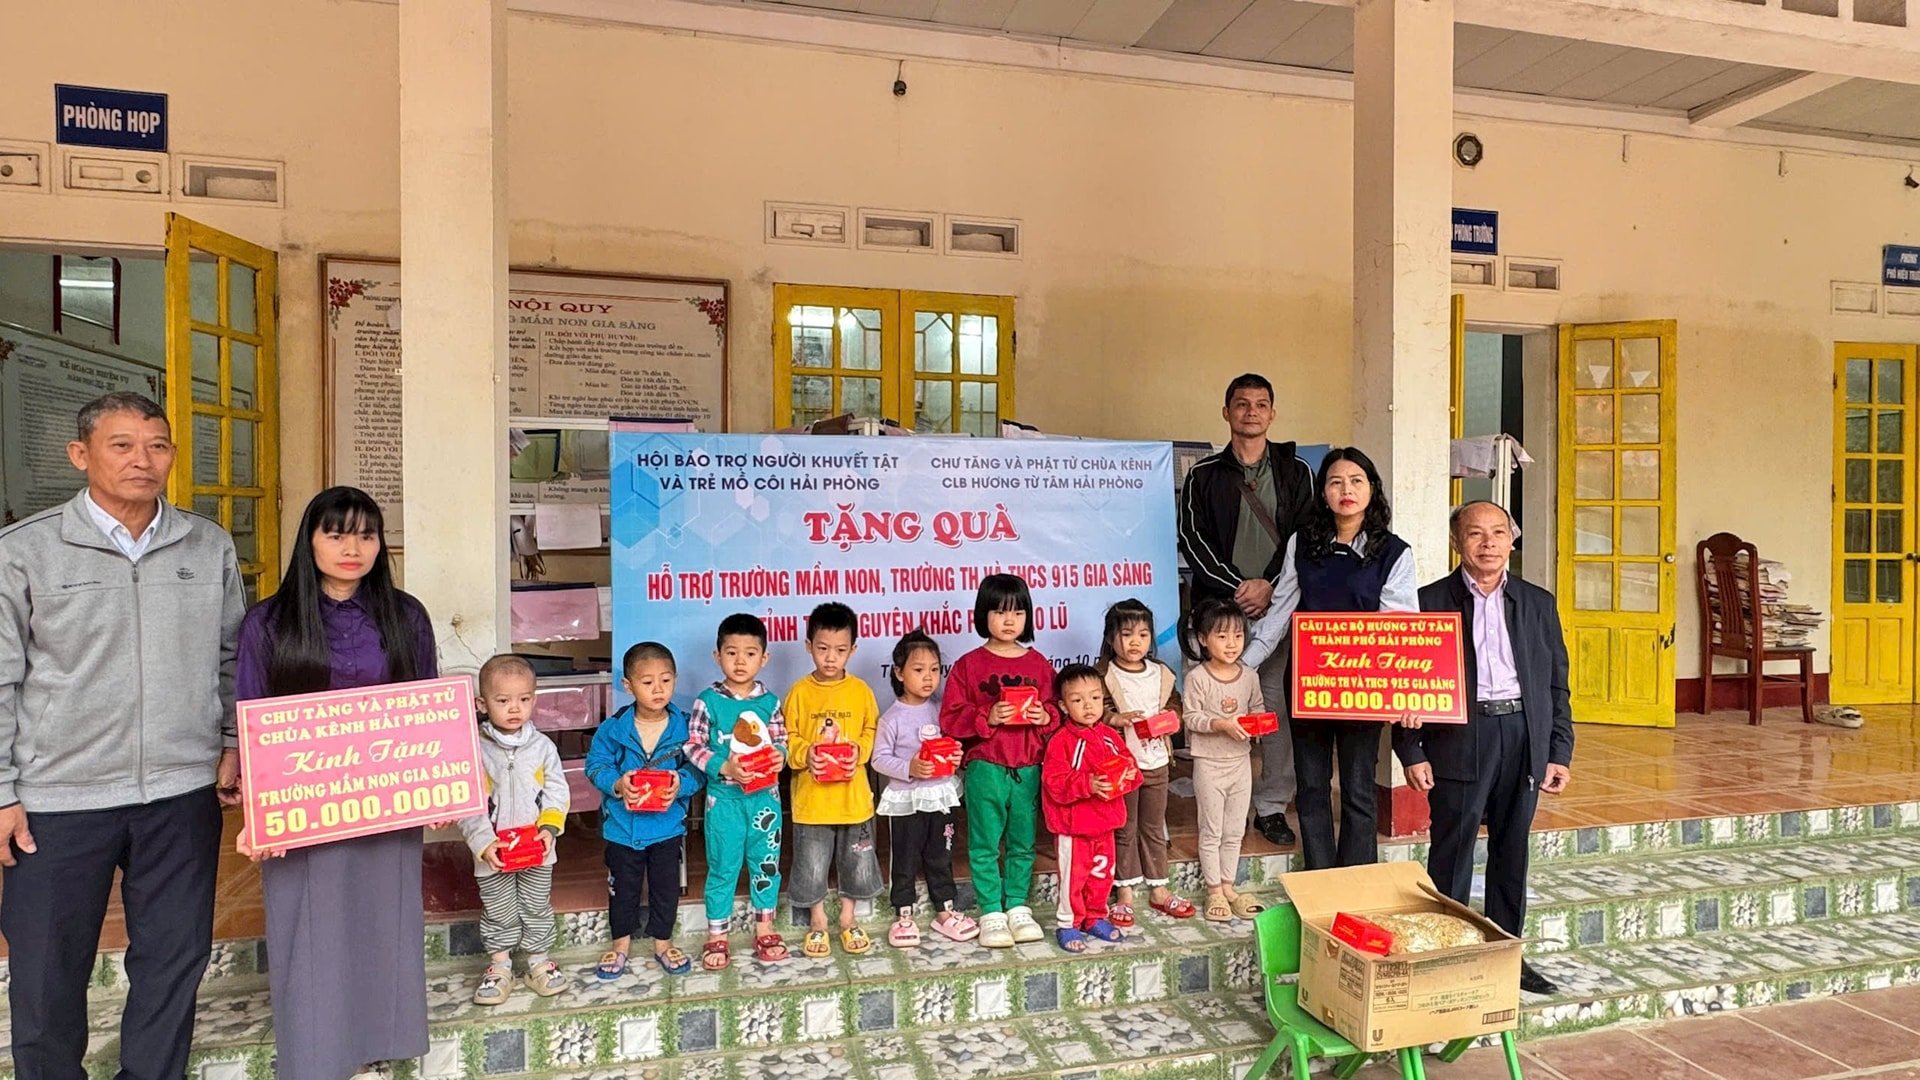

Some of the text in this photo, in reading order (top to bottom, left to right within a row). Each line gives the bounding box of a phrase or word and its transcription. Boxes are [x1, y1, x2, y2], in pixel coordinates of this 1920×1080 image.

[63, 101, 161, 138] PHÒNG HỌP
[509, 298, 613, 314] NỘI QUY
[558, 318, 588, 328] NON
[592, 320, 615, 329] GIA
[637, 449, 899, 472] HỘI BẢO TRỢ NGƯỜI KHUYẾT TẬT
[931, 457, 961, 469] CHƯ
[1004, 455, 1023, 469] VÀ
[1027, 456, 1059, 473] PHẬT
[1062, 455, 1079, 470] TỬ
[1081, 456, 1117, 470] CHÙA
[1120, 457, 1152, 471] KÊNH
[660, 472, 880, 490] VÀ TRẺ MỒ CÔI HẢI PHÒNG
[942, 476, 968, 488] CLB
[972, 476, 1020, 489] HƯƠNG
[1043, 476, 1070, 489] TÂM
[1073, 475, 1095, 489] HẢI
[1099, 476, 1143, 489] PHÒNG
[804, 502, 1020, 551] TẶNG QUÀ
[648, 564, 673, 600] HỖ
[678, 570, 713, 604] TRỢ
[719, 565, 790, 598] TRƯỜNG
[795, 561, 839, 596] MẦM
[845, 568, 886, 596] NON,
[890, 562, 955, 593] TRƯỜNG
[959, 566, 979, 590] TH
[1052, 564, 1079, 588] 915
[1084, 563, 1109, 588] GIA
[1113, 558, 1153, 586] SÀNG
[859, 606, 914, 639] GUYÊN
[920, 601, 962, 636] KHẮC
[1051, 601, 1068, 630] LŨ
[1300, 620, 1323, 632] CÂU
[1325, 622, 1347, 633] LẠC
[1350, 620, 1365, 633] BỘ
[1367, 621, 1408, 632] HƯƠNG
[1427, 620, 1454, 632] TÂM
[1310, 633, 1442, 646] THÀNH PHỐ HẢI PHÒNG
[1076, 654, 1089, 666] 10
[1377, 652, 1434, 673] Tặng
[1301, 674, 1455, 690] TRƯỜNG TH VÀ THCS 915 GIA SÀNG
[260, 687, 456, 725] CHƯ TĂNG VÀ PHẬT TỬ
[1304, 690, 1454, 712] 80.000.000Đ
[316, 720, 366, 738] KÊNH
[369, 713, 401, 732] HẢI
[404, 708, 461, 726] PHÒNG
[369, 738, 443, 763] Tặng
[258, 760, 471, 807] TRƯỜNG MẦM NON GIA SÀNG
[264, 780, 471, 837] 50.000.000Đ
